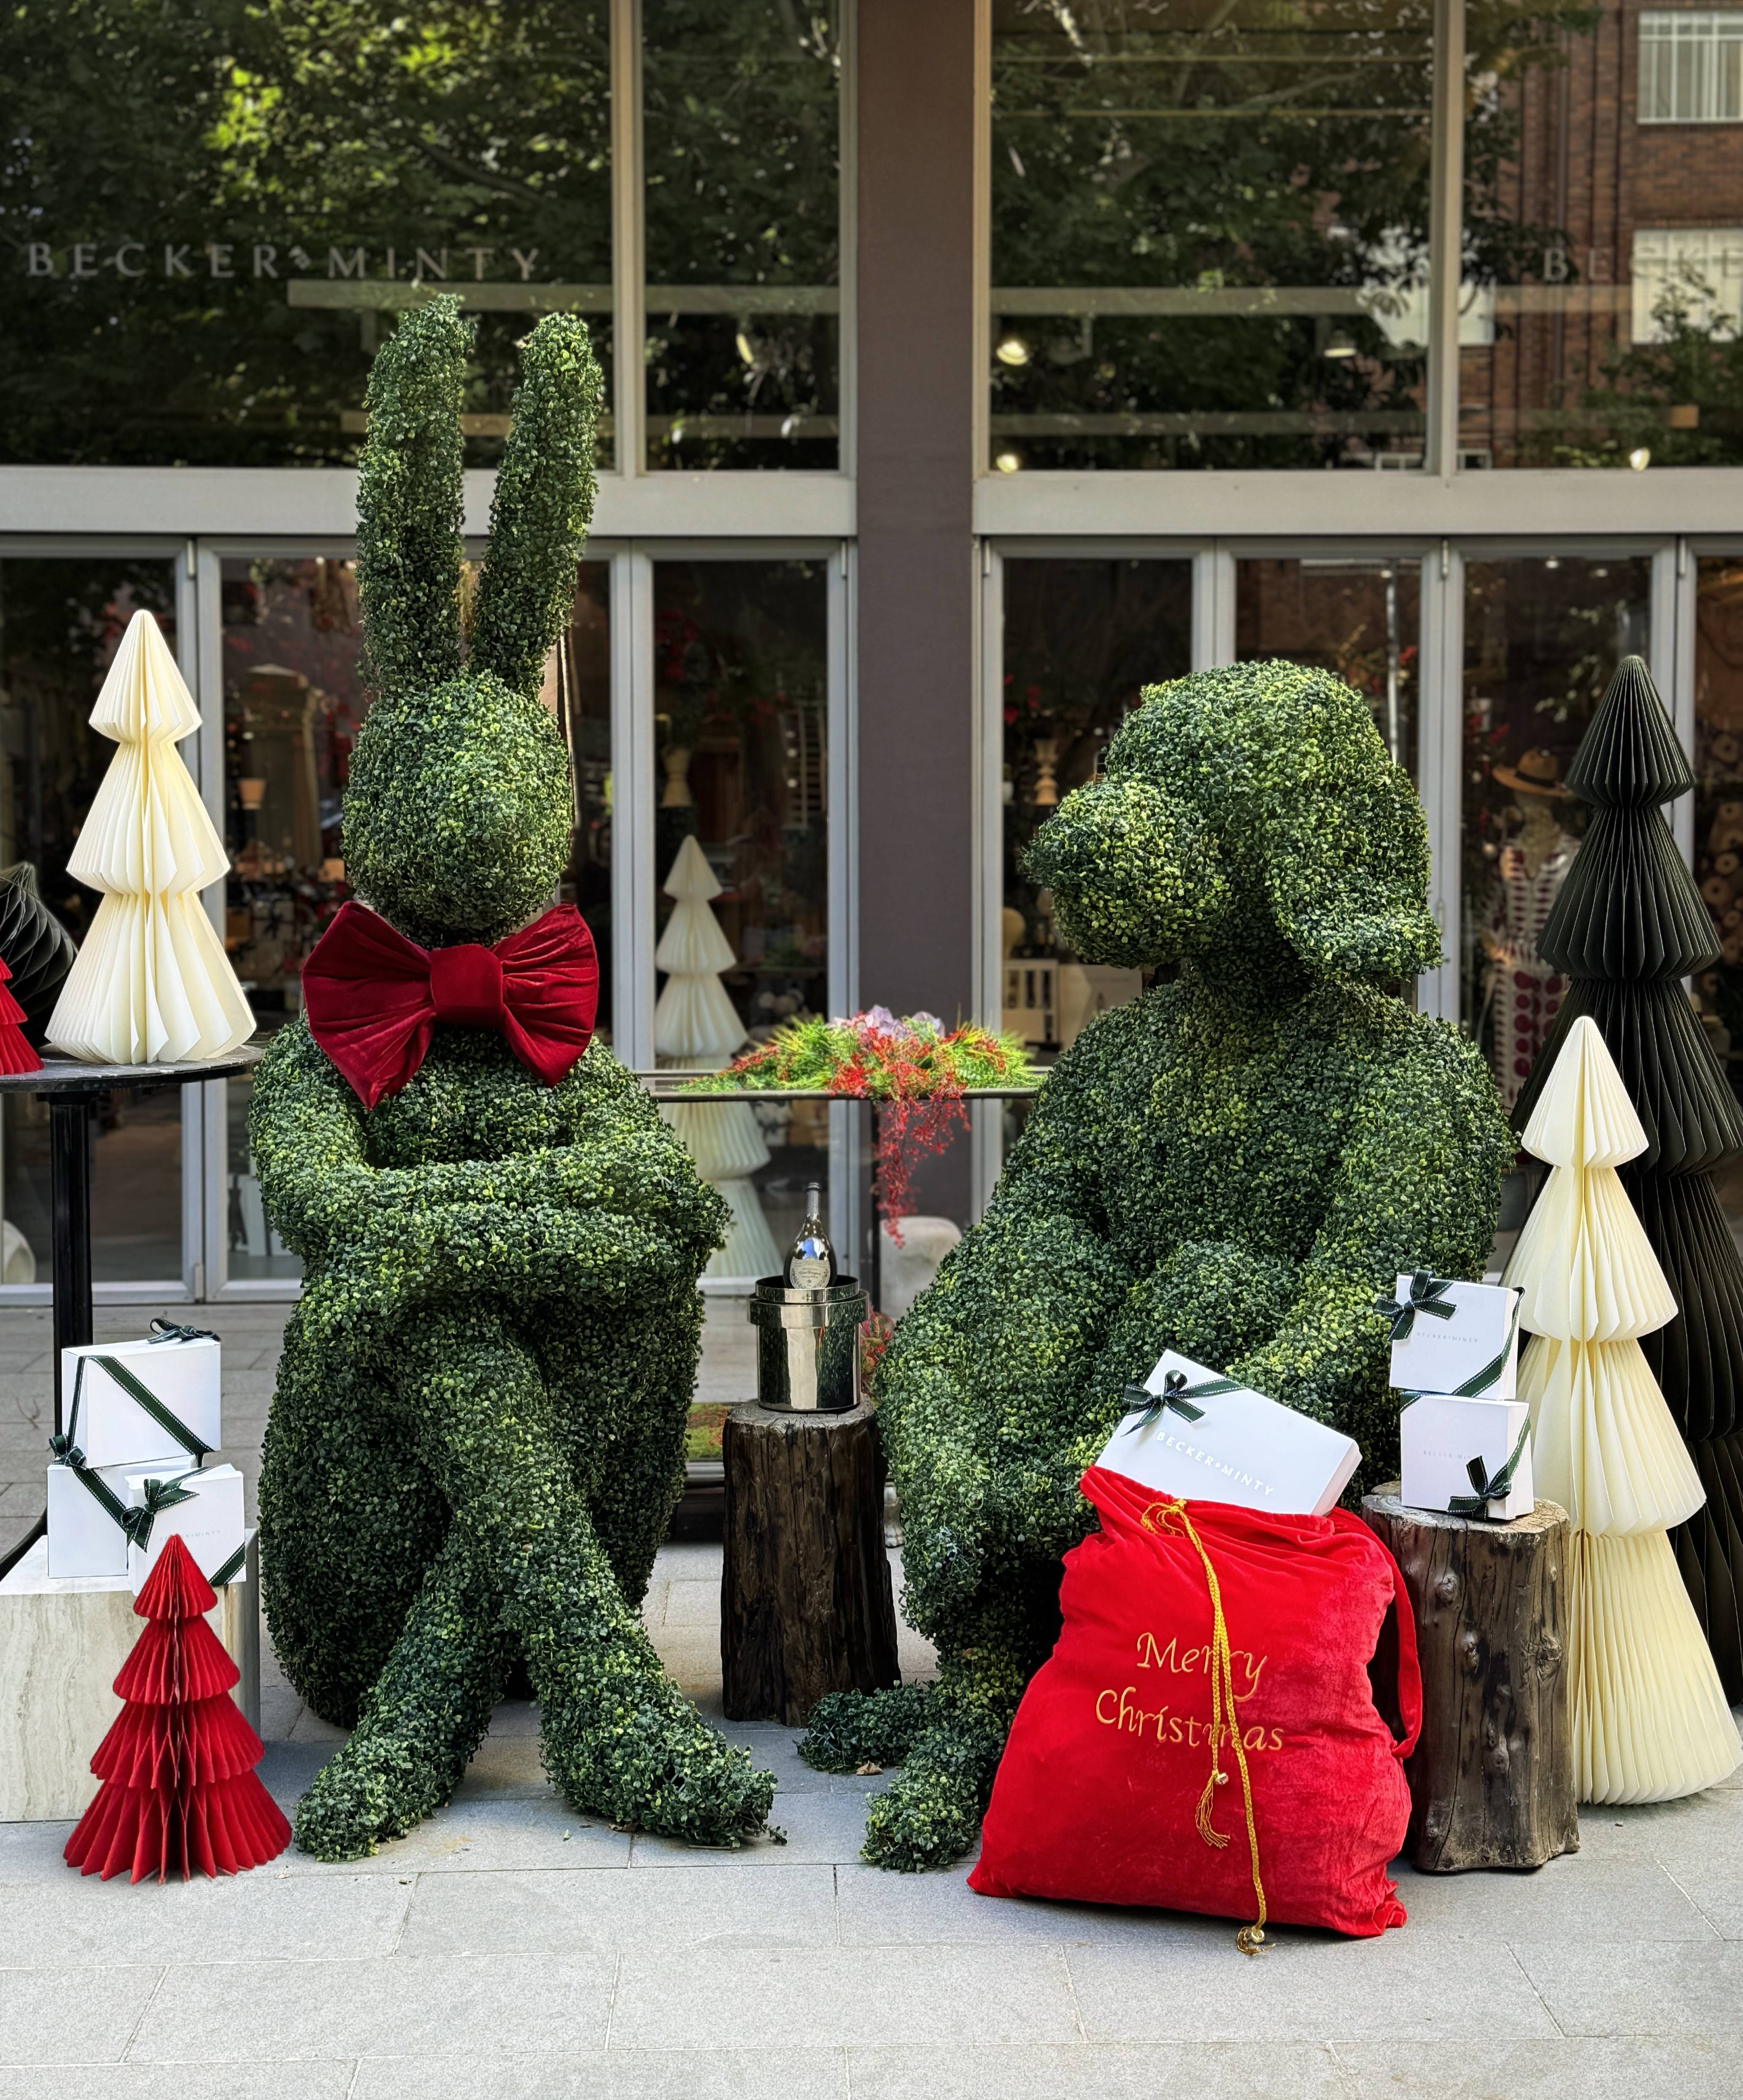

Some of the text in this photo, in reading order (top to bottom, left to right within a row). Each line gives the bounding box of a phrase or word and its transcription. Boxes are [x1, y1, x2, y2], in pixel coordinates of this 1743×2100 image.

[29, 243, 540, 280] BECKER MINTY
[1156, 1431, 1274, 1496] BECKER MINTY
[1095, 1686, 1284, 1751] Christmas
